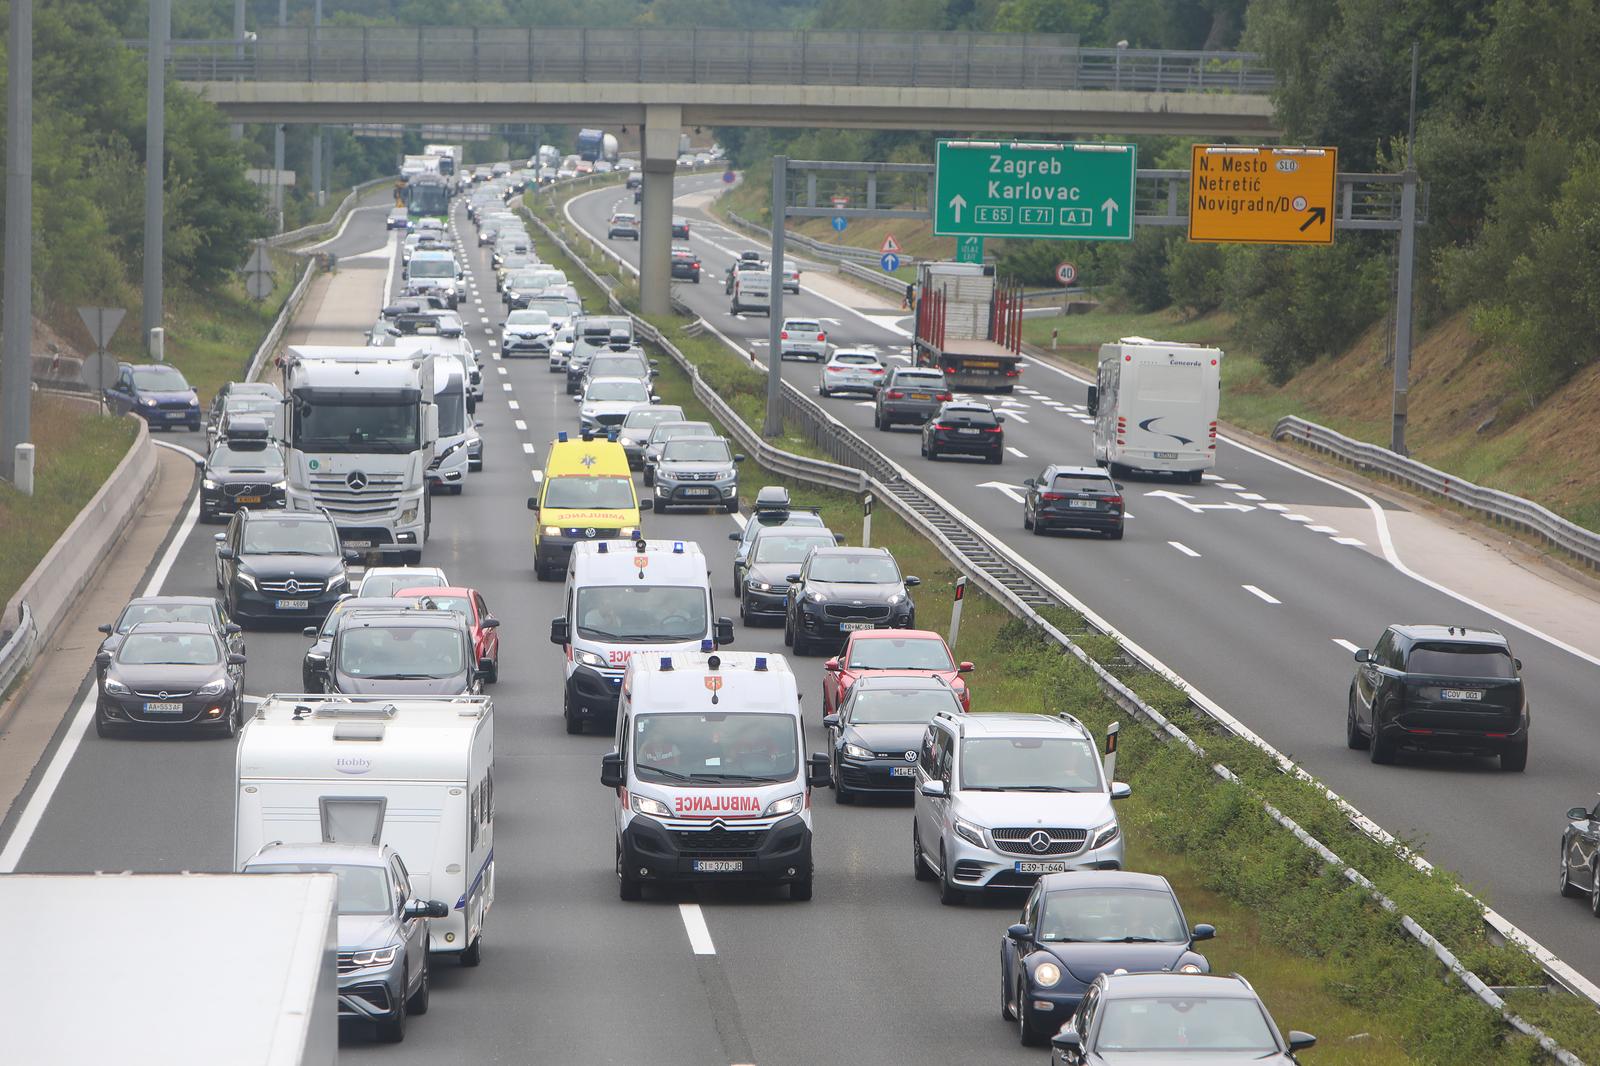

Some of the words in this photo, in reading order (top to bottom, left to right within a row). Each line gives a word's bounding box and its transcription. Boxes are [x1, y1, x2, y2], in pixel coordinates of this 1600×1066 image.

[989, 155, 1062, 178] Zagreb
[1199, 156, 1215, 172] N.
[1222, 157, 1268, 173] Mesto
[1279, 161, 1296, 170] SLO
[1199, 175, 1261, 192] Netretić
[988, 180, 1081, 201] Karlovac
[980, 208, 988, 221] E
[992, 208, 1008, 222] 65
[1025, 209, 1031, 222] E
[1036, 209, 1049, 222] 71
[1067, 210, 1077, 223] A
[1060, 267, 1073, 279] 40
[336, 758, 371, 769] Hobby
[1020, 863, 1063, 872] E39-T-646
